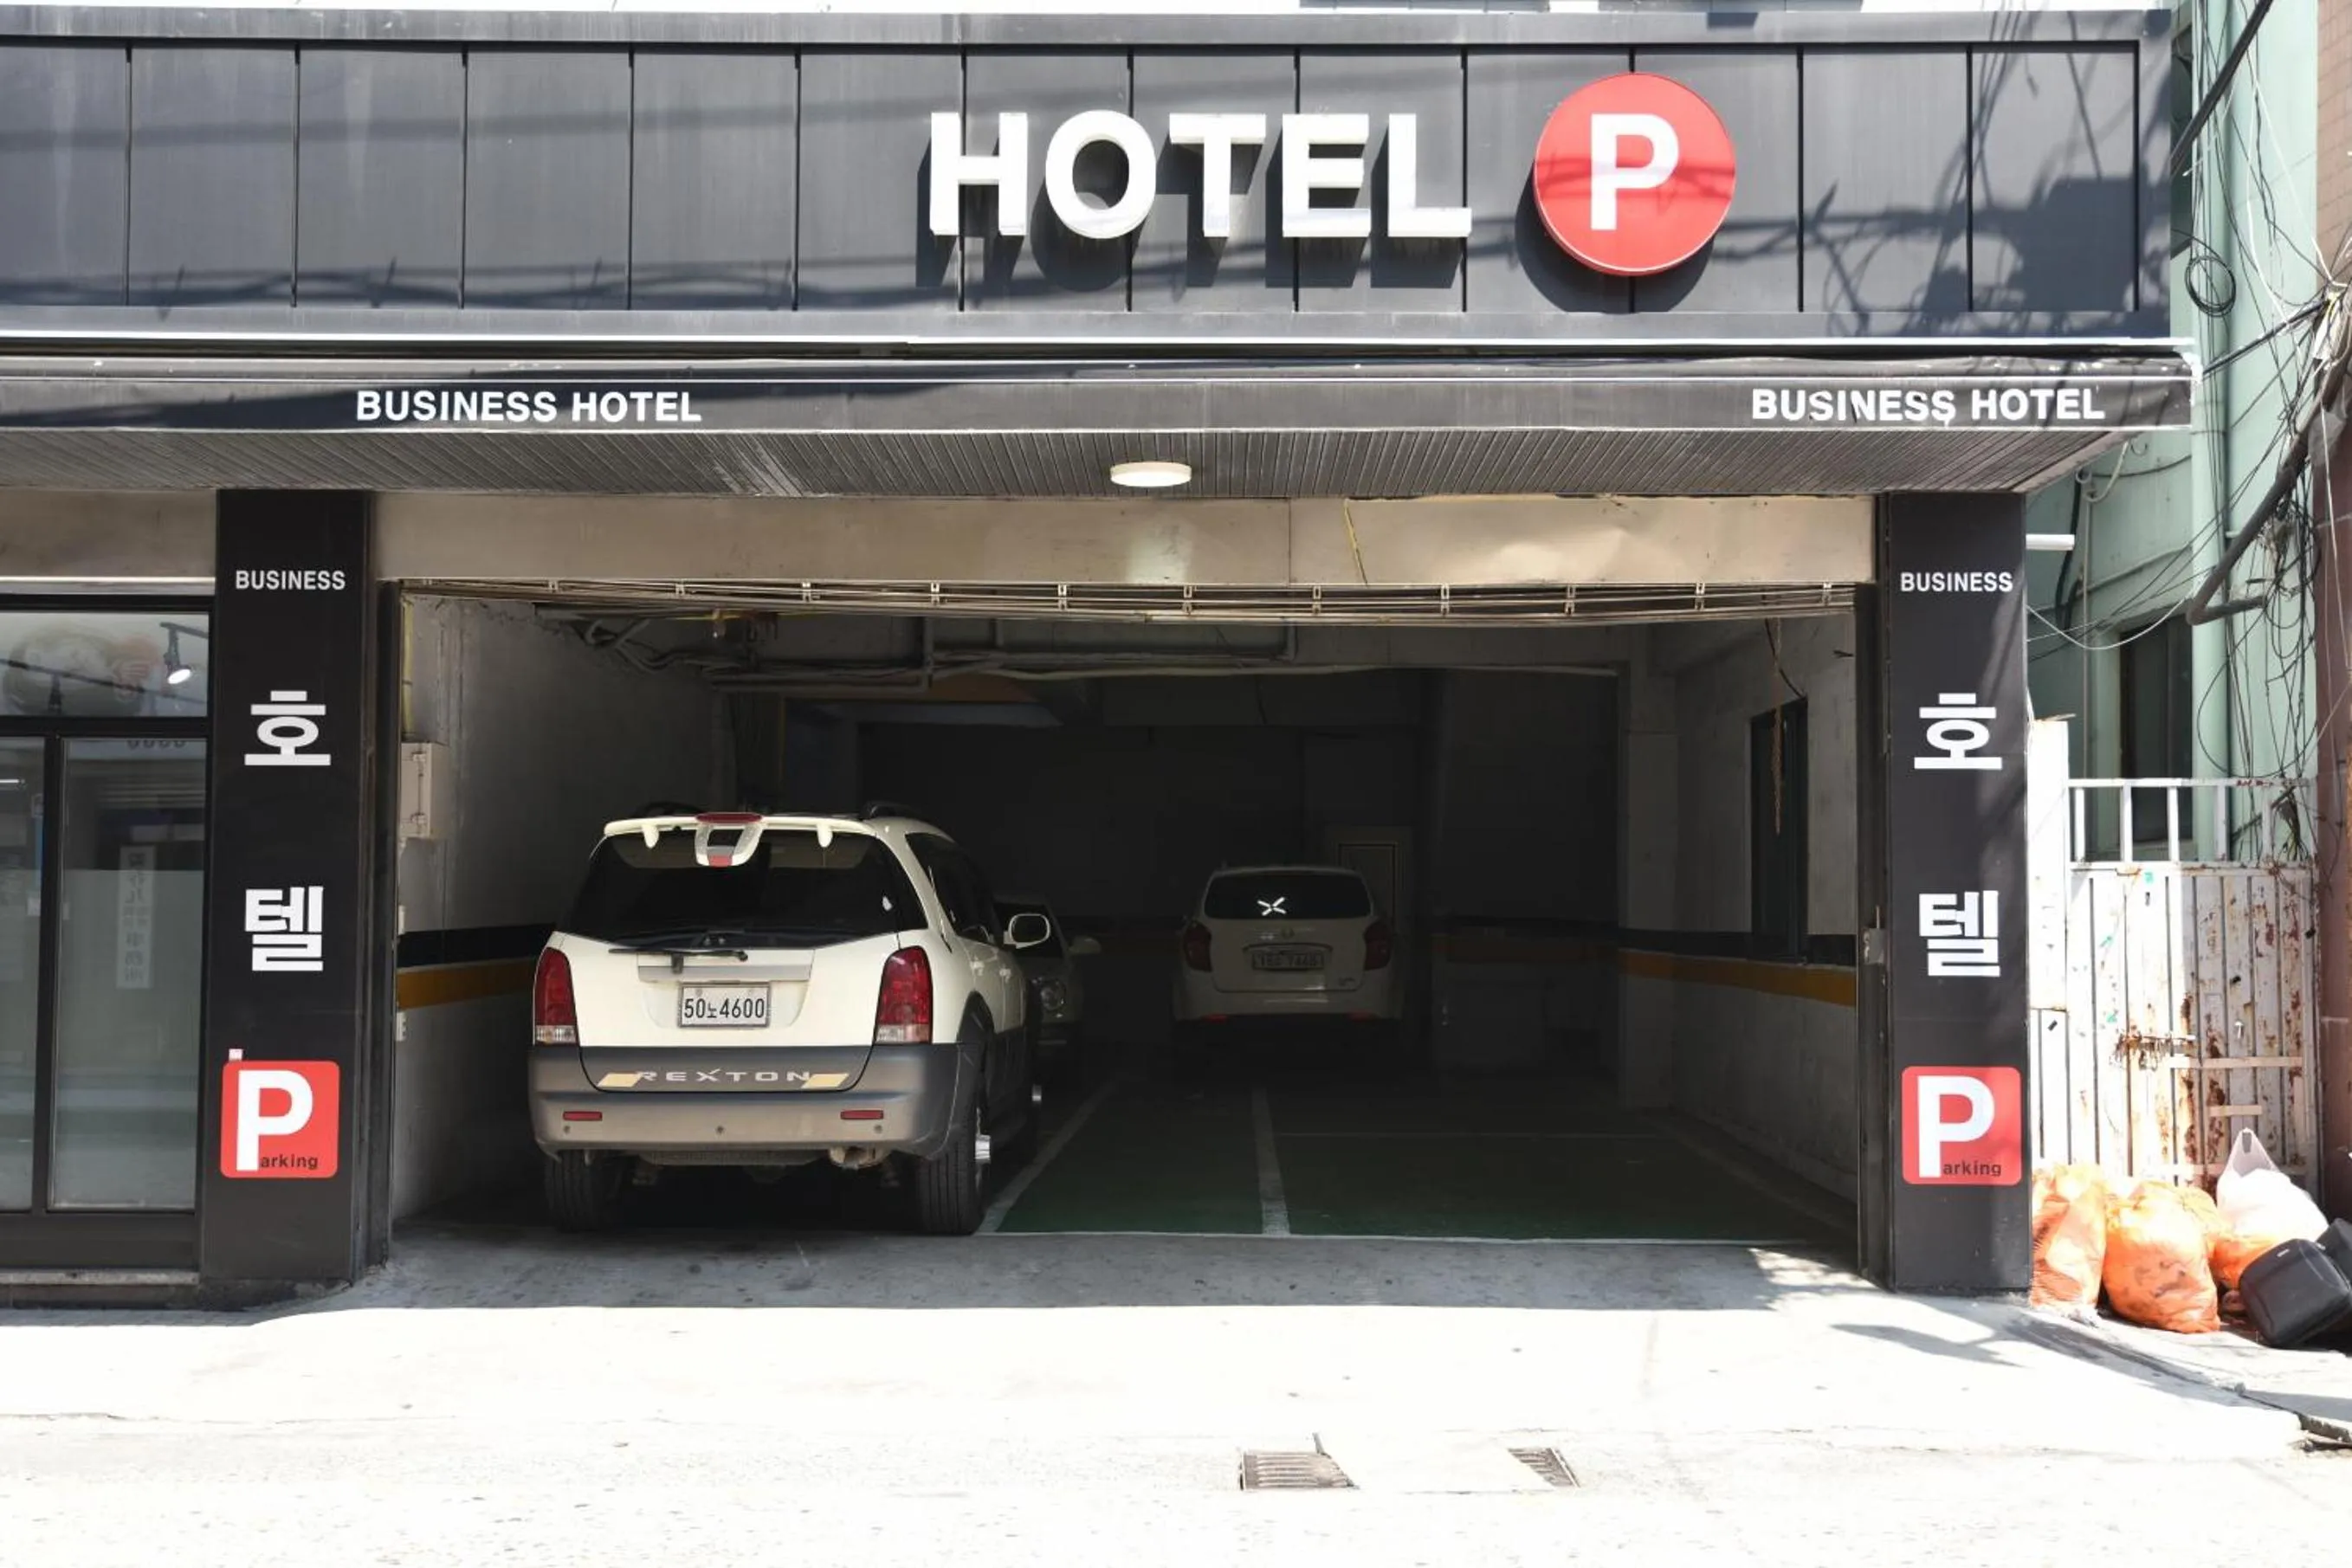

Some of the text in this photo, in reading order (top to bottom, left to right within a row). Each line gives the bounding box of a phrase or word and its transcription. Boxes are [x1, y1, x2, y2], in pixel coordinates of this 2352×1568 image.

[929, 109, 1472, 240] HOTEL
[1590, 113, 1680, 230] P
[356, 390, 702, 423] BUSINESS HOTEL
[1751, 388, 2106, 423] BUSINESS HOTEL
[235, 570, 346, 590] BUSINESS
[1900, 571, 2013, 592] BUSINESS
[684, 997, 765, 1018] 50노4600
[636, 1068, 811, 1081] REXTON
